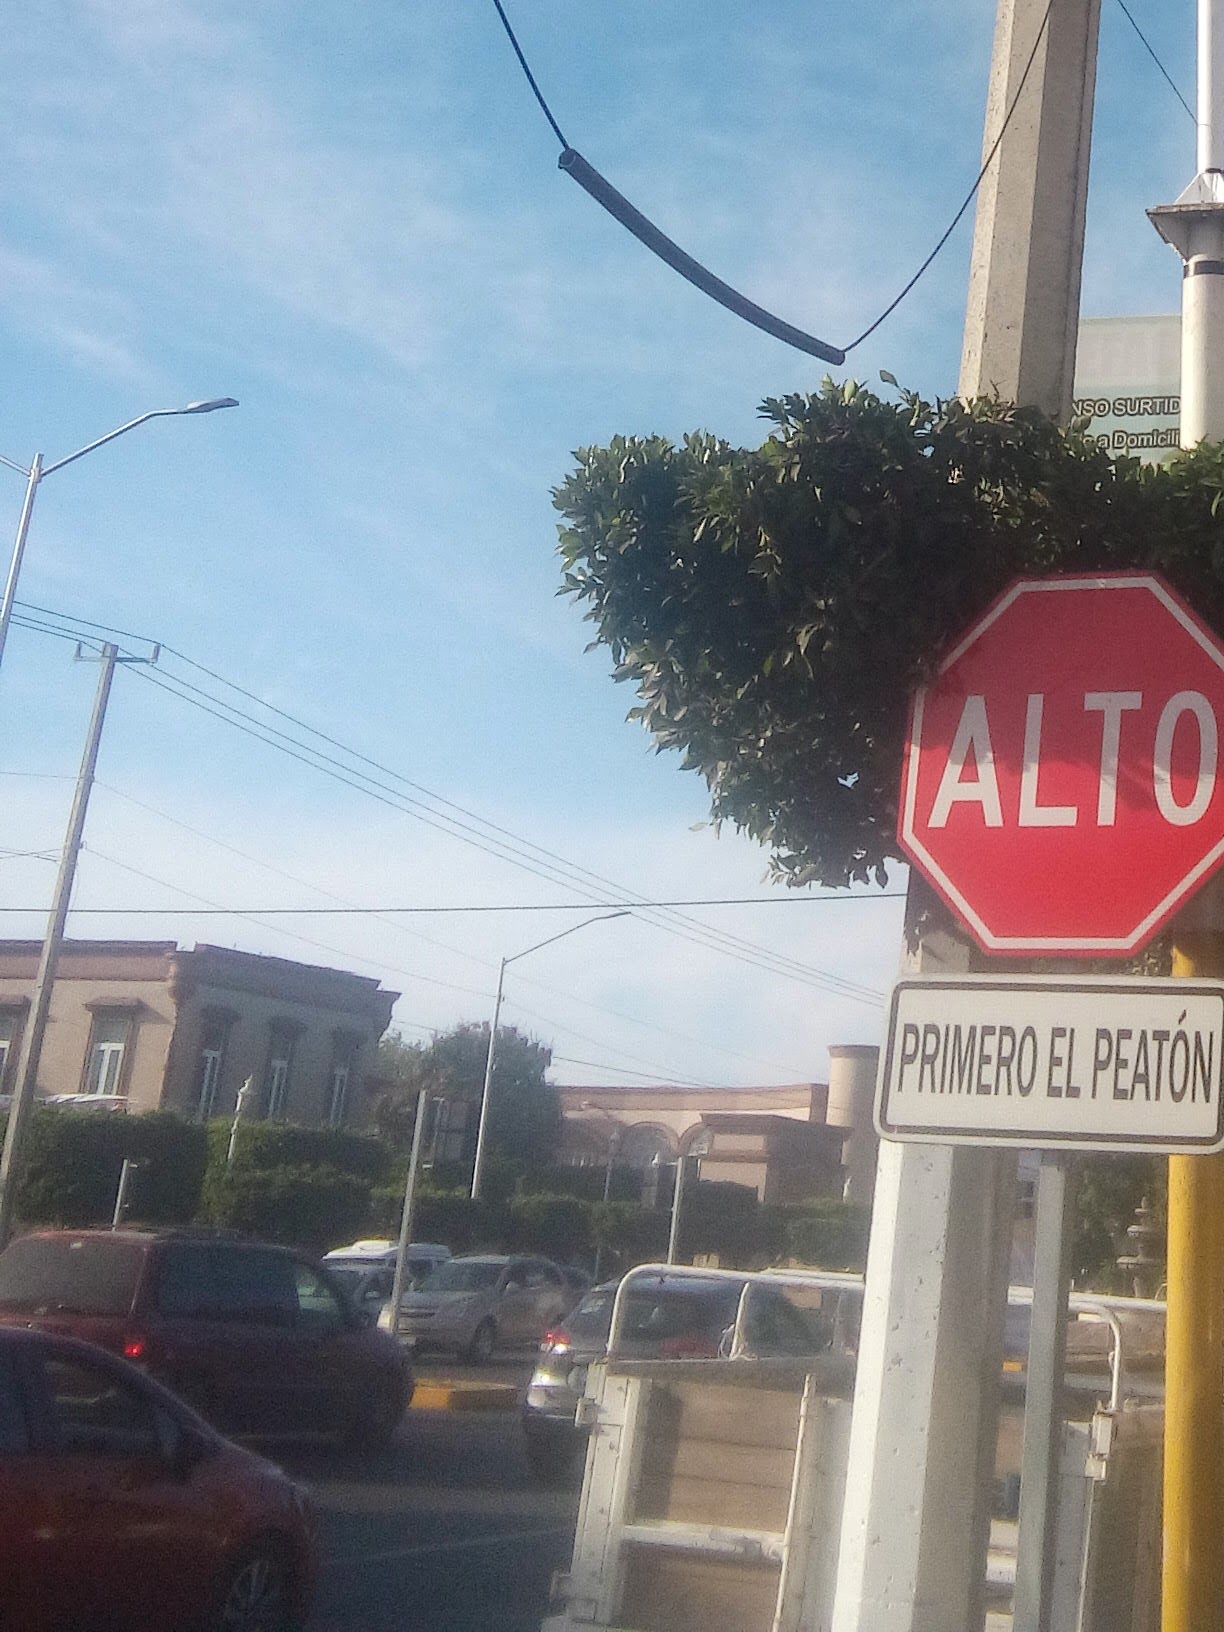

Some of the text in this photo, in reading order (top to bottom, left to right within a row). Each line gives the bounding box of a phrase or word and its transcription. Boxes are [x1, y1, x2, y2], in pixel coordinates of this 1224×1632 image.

[1113, 429, 1181, 449] Domicili
[927, 689, 1219, 829] ALTO
[899, 1009, 1215, 1104] PRIMERO EL PEATÓN
